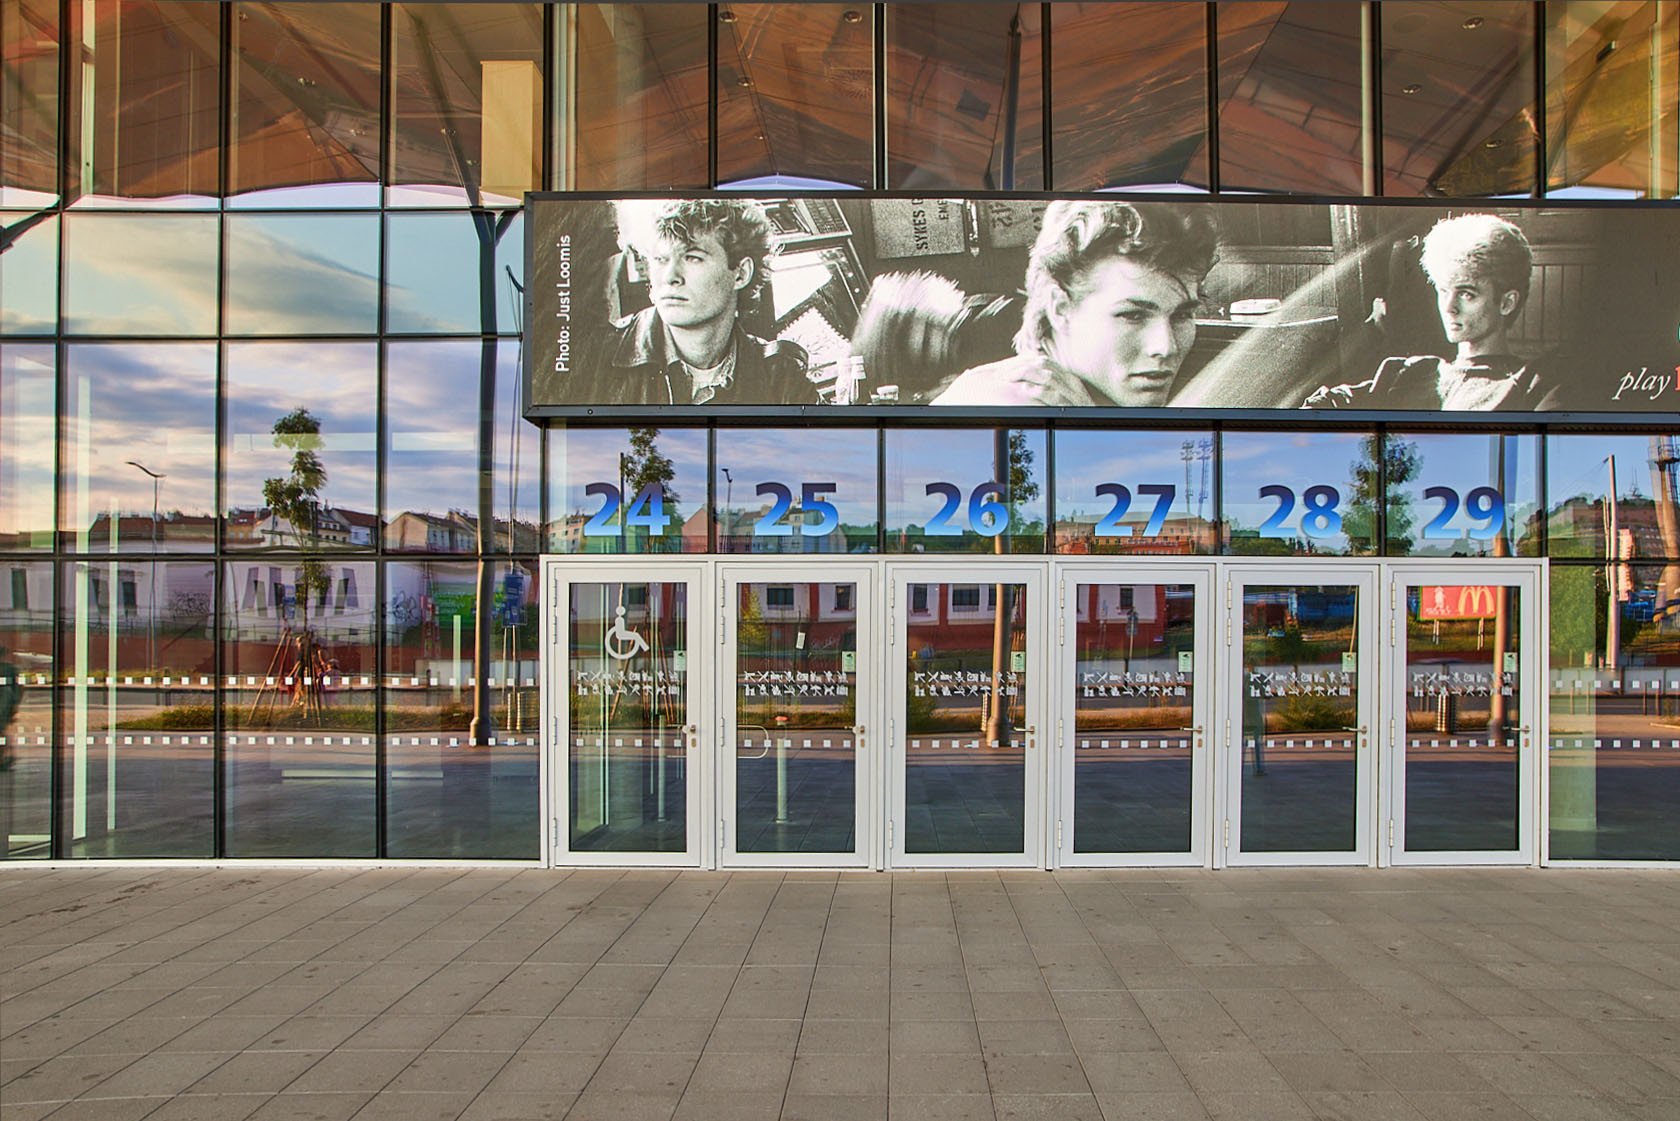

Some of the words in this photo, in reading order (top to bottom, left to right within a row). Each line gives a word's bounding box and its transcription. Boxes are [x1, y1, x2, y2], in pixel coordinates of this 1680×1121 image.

[912, 210, 929, 250] SYKES
[556, 234, 571, 287] Loomis
[556, 291, 570, 322] Just
[555, 326, 570, 372] Photo:
[1611, 367, 1671, 400] play
[584, 482, 670, 536] 24
[754, 482, 839, 536] 25
[924, 482, 1009, 536] 26
[1095, 483, 1176, 536] 27
[1259, 485, 1343, 538] 28
[1422, 486, 1504, 539] 29
